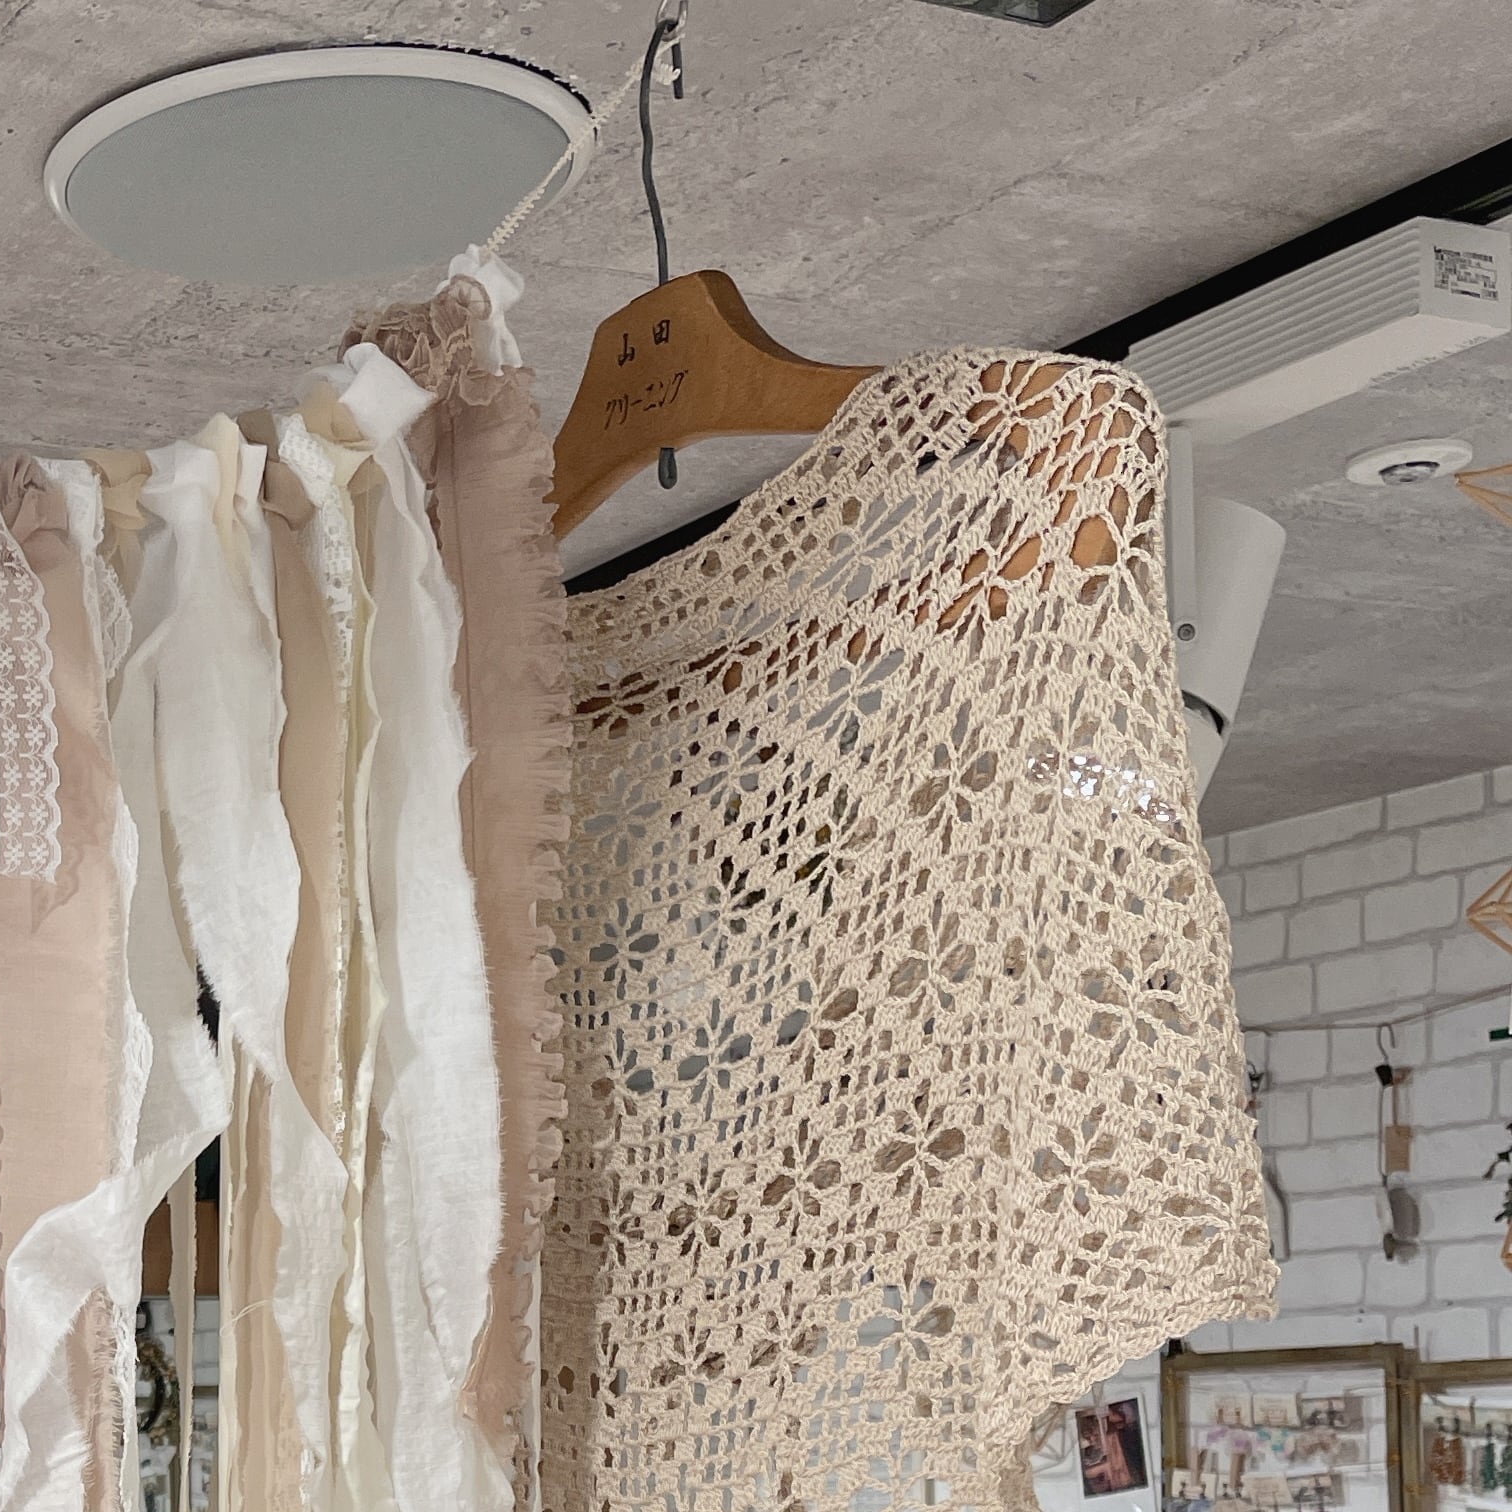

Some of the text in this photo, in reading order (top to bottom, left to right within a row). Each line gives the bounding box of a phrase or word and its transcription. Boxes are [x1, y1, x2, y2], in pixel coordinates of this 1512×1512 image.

[617, 318, 671, 367] 山田
[604, 369, 688, 431] クリーニング
